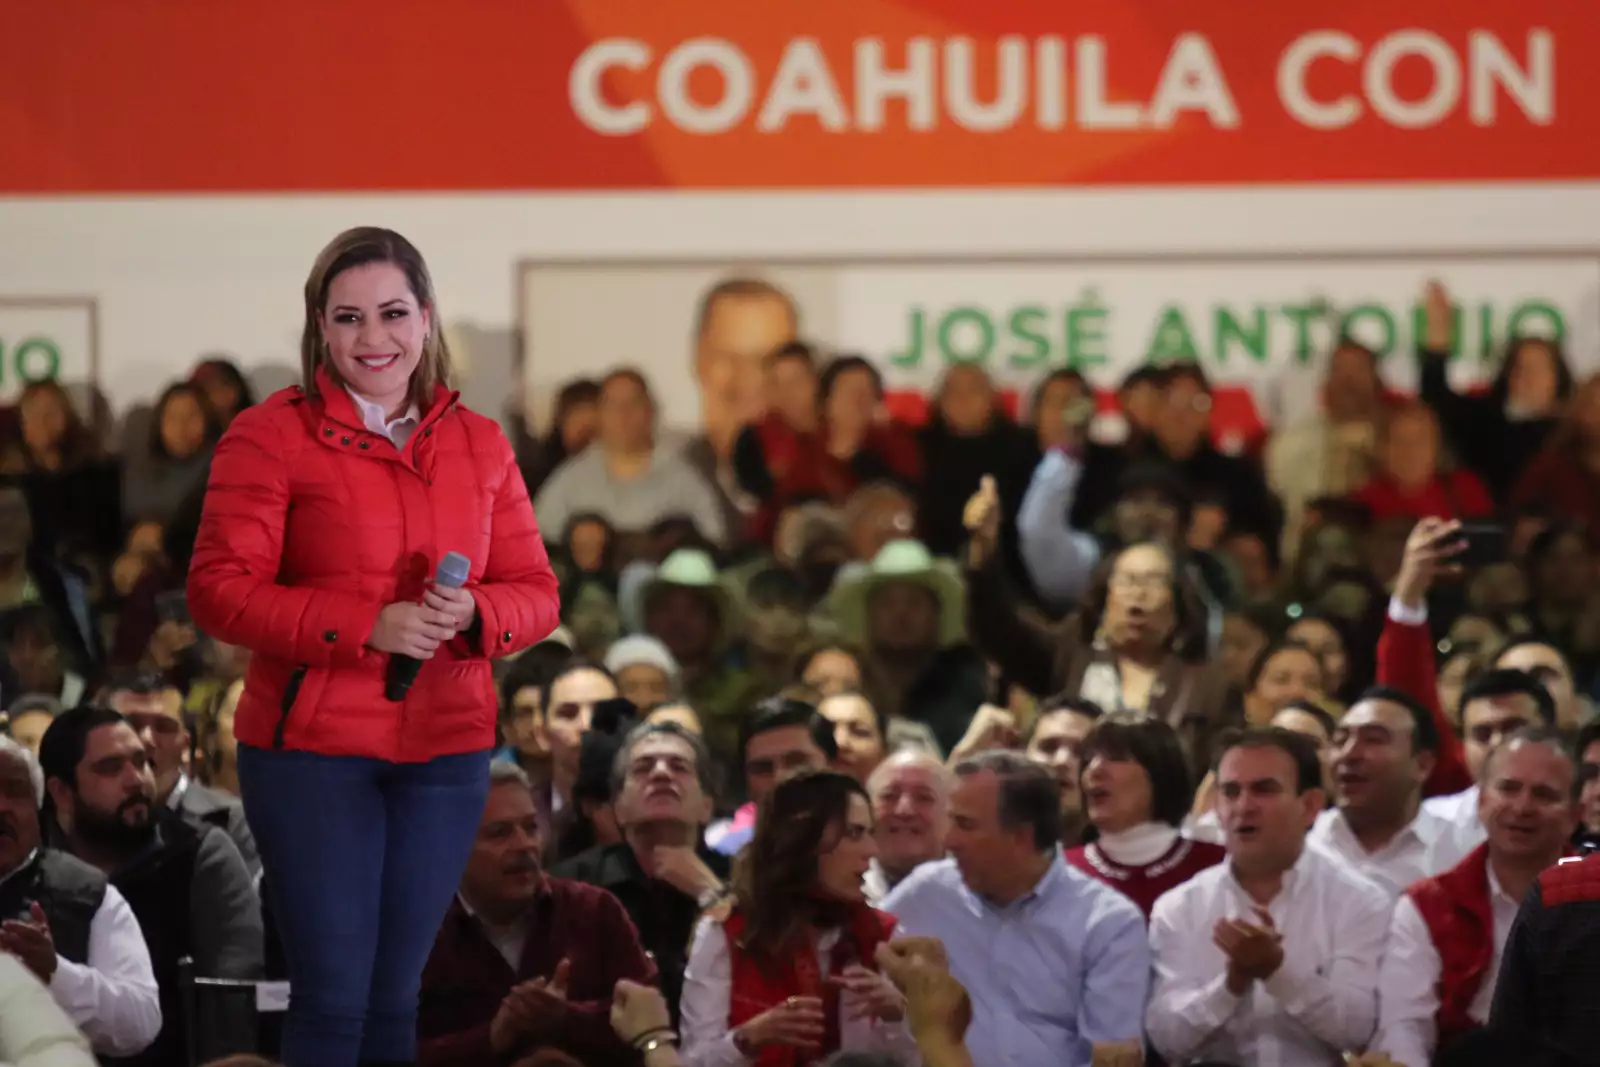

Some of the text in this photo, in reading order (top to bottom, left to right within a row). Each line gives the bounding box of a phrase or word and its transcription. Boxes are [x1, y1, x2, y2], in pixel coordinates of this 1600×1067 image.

[569, 28, 1555, 134] COAHUILA CON
[890, 288, 1110, 370] JOSÉ
